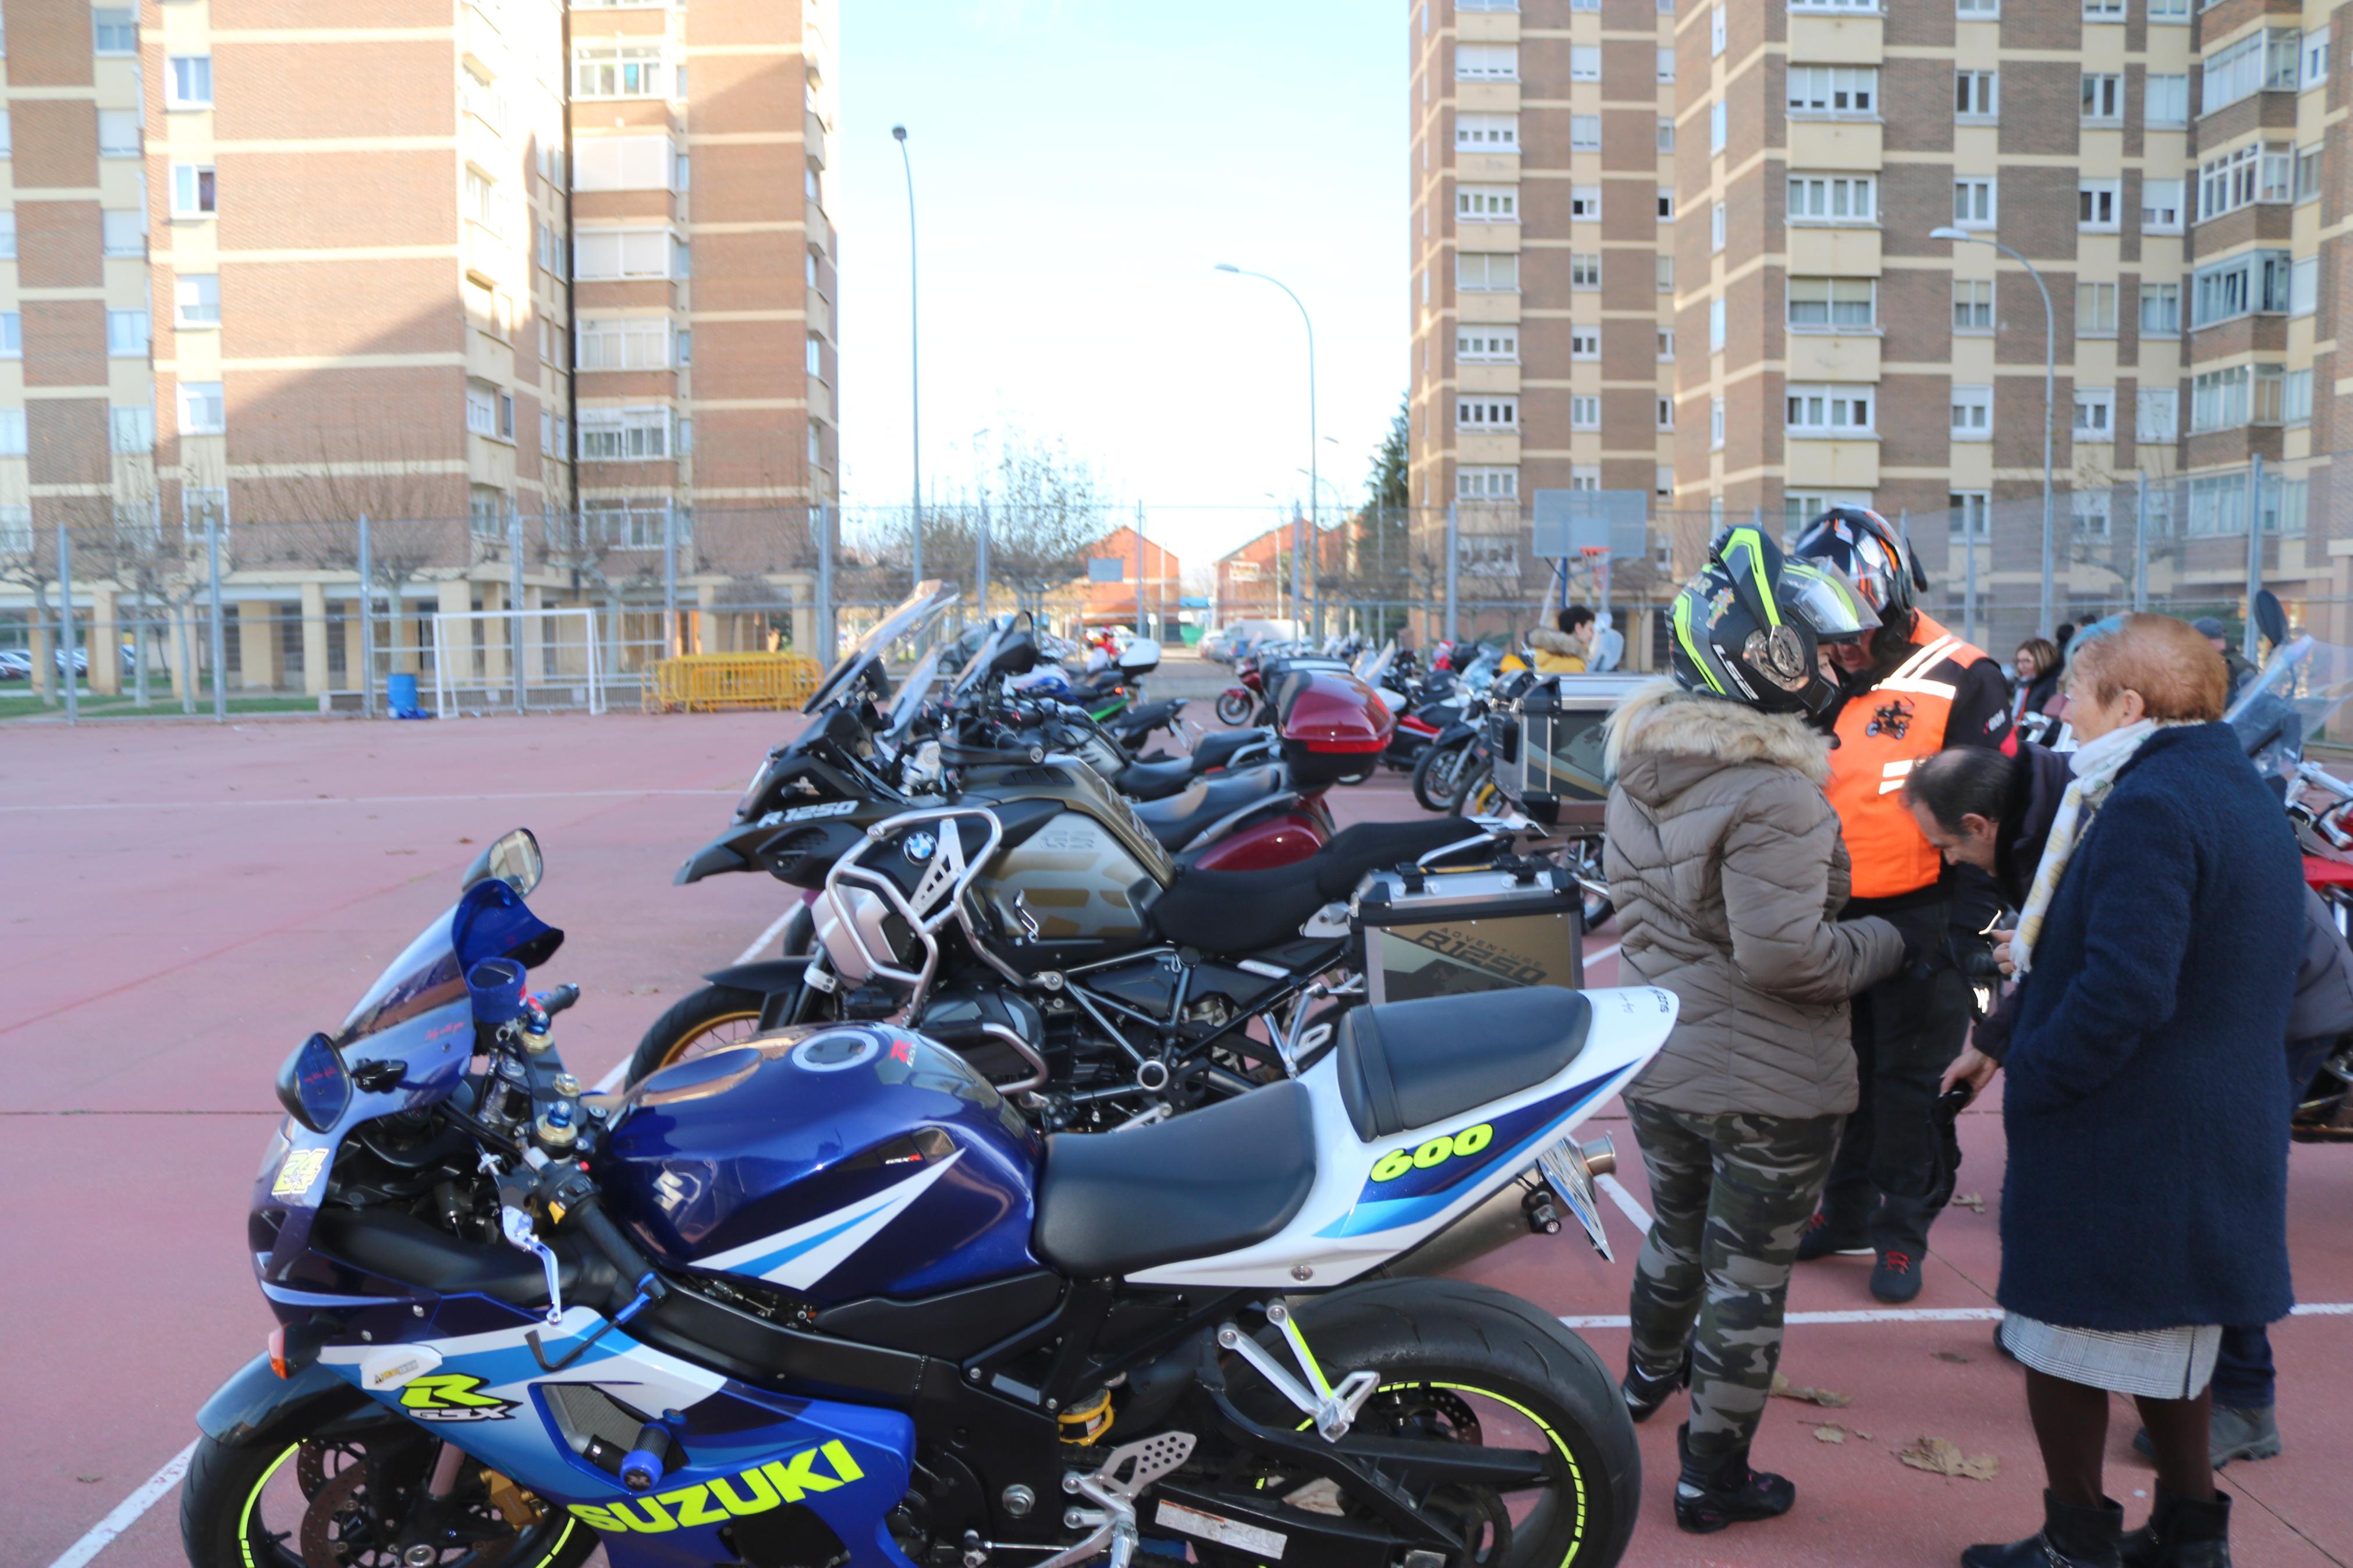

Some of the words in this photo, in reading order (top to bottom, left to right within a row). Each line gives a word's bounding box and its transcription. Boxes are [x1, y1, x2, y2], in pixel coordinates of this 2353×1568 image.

[1712, 645, 1759, 700] LS2
[1414, 930, 1548, 986] R1250
[1440, 927, 1542, 968] ADVENTURE
[272, 1149, 329, 1194] 24
[1369, 1123, 1494, 1182] 600
[399, 1373, 503, 1408] R
[409, 1405, 509, 1420] GSX
[567, 1439, 865, 1533] SUZUKI
